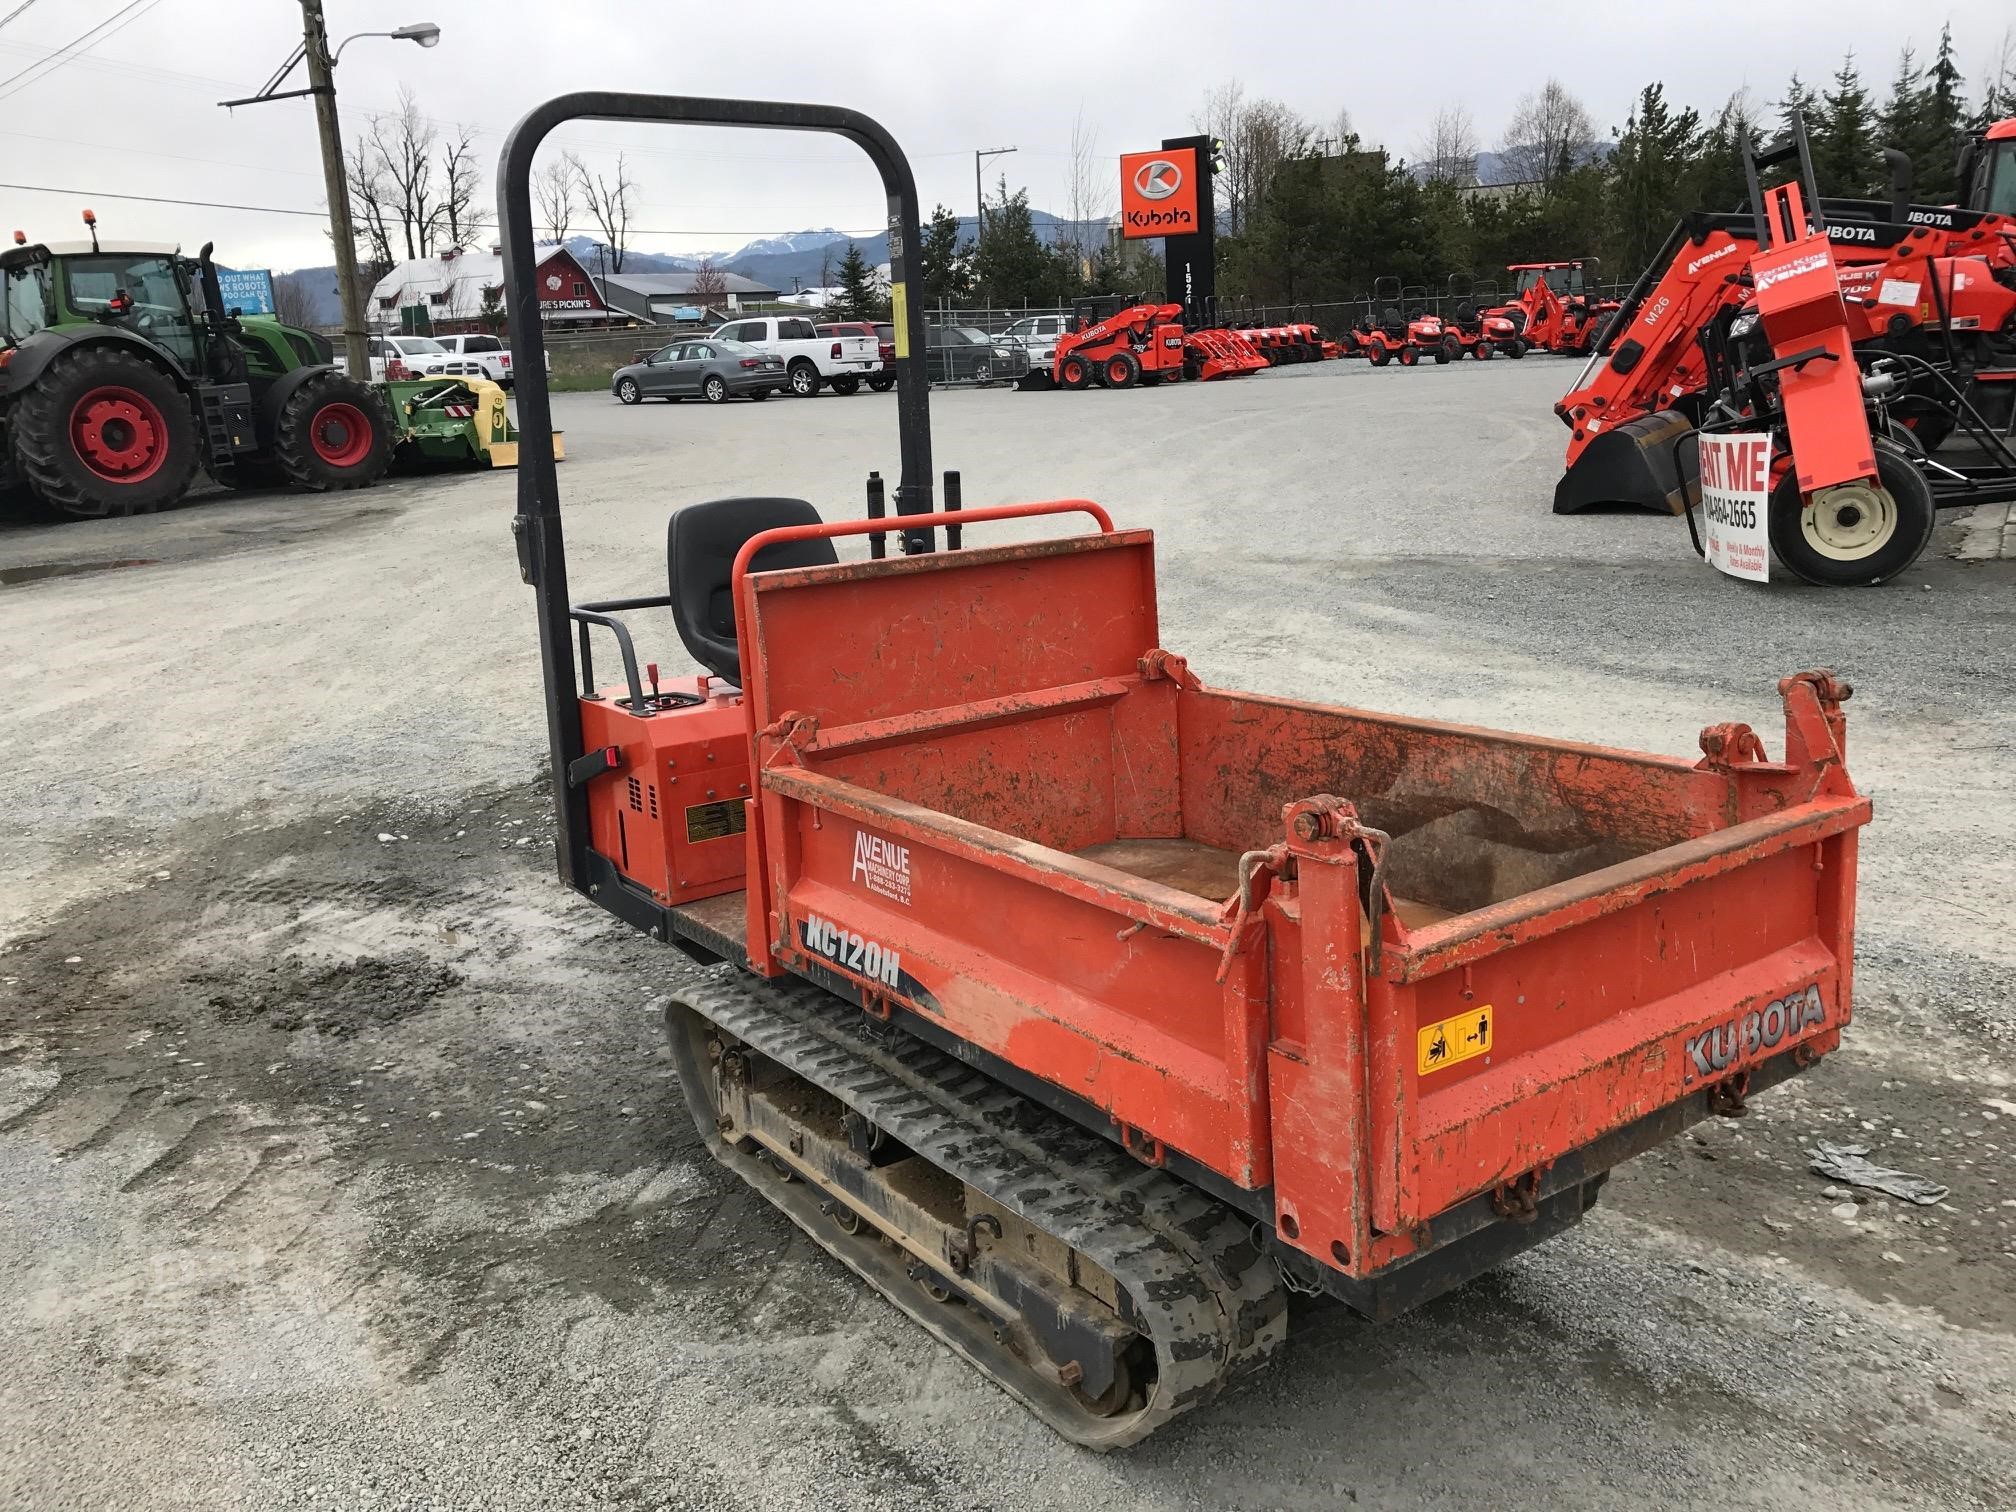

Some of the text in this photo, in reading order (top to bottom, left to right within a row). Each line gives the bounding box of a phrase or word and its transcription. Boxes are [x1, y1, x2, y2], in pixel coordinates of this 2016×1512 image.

[1128, 207, 1191, 227] Kubota
[1688, 243, 1737, 275] AVENUE
[1756, 258, 1828, 292] AVENUE
[225, 274, 240, 282] OUT
[243, 272, 264, 281] WHAT
[232, 281, 266, 292] ROBOTS
[1644, 296, 1670, 326] M26
[1081, 325, 1107, 341] KUBOTA
[1725, 441, 1768, 492] ME
[852, 830, 911, 889] AVENUE
[806, 913, 900, 988] KC120H
[1684, 983, 1825, 1084] KUBOTA
